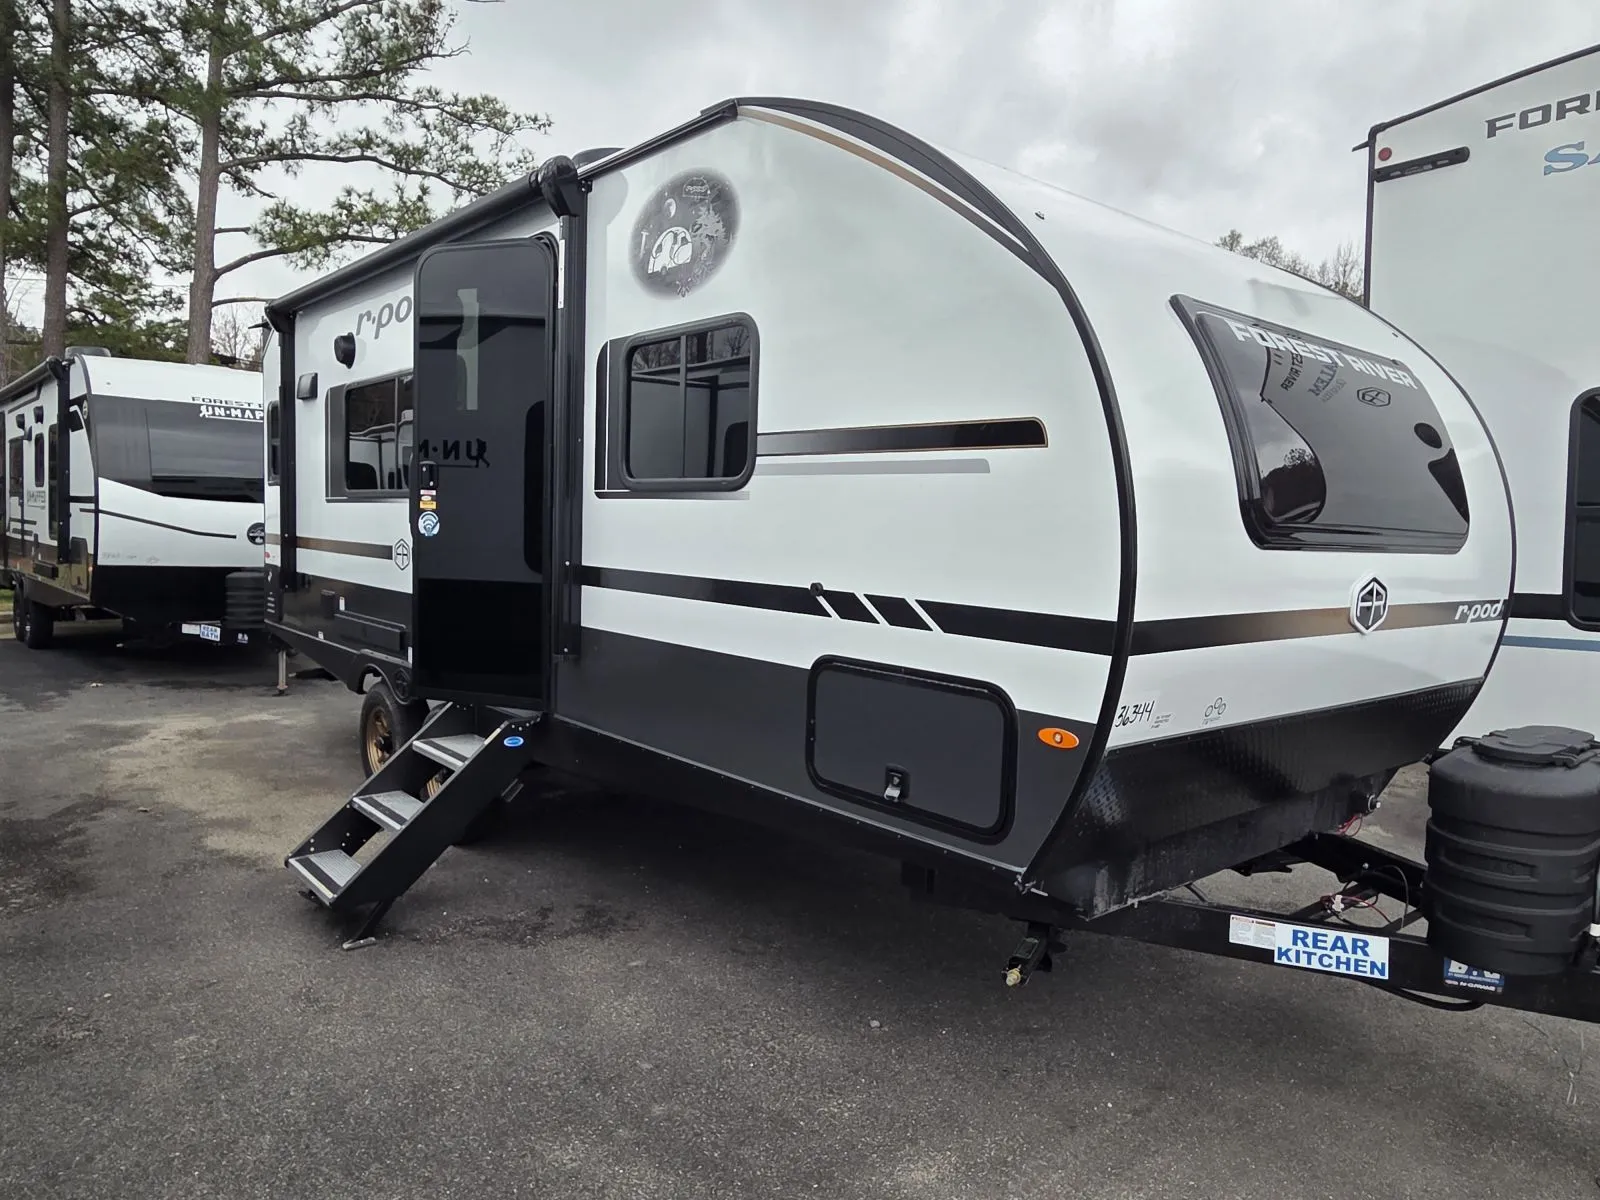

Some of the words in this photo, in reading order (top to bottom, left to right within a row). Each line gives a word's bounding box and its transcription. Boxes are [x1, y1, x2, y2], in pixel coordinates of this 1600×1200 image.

[1543, 140, 1600, 176] S
[1224, 317, 1344, 367] FOREST
[1342, 352, 1418, 389] RIVER
[191, 396, 253, 407] FOREST
[1292, 929, 1370, 957] REAR
[1277, 946, 1386, 977] KITCHEN
